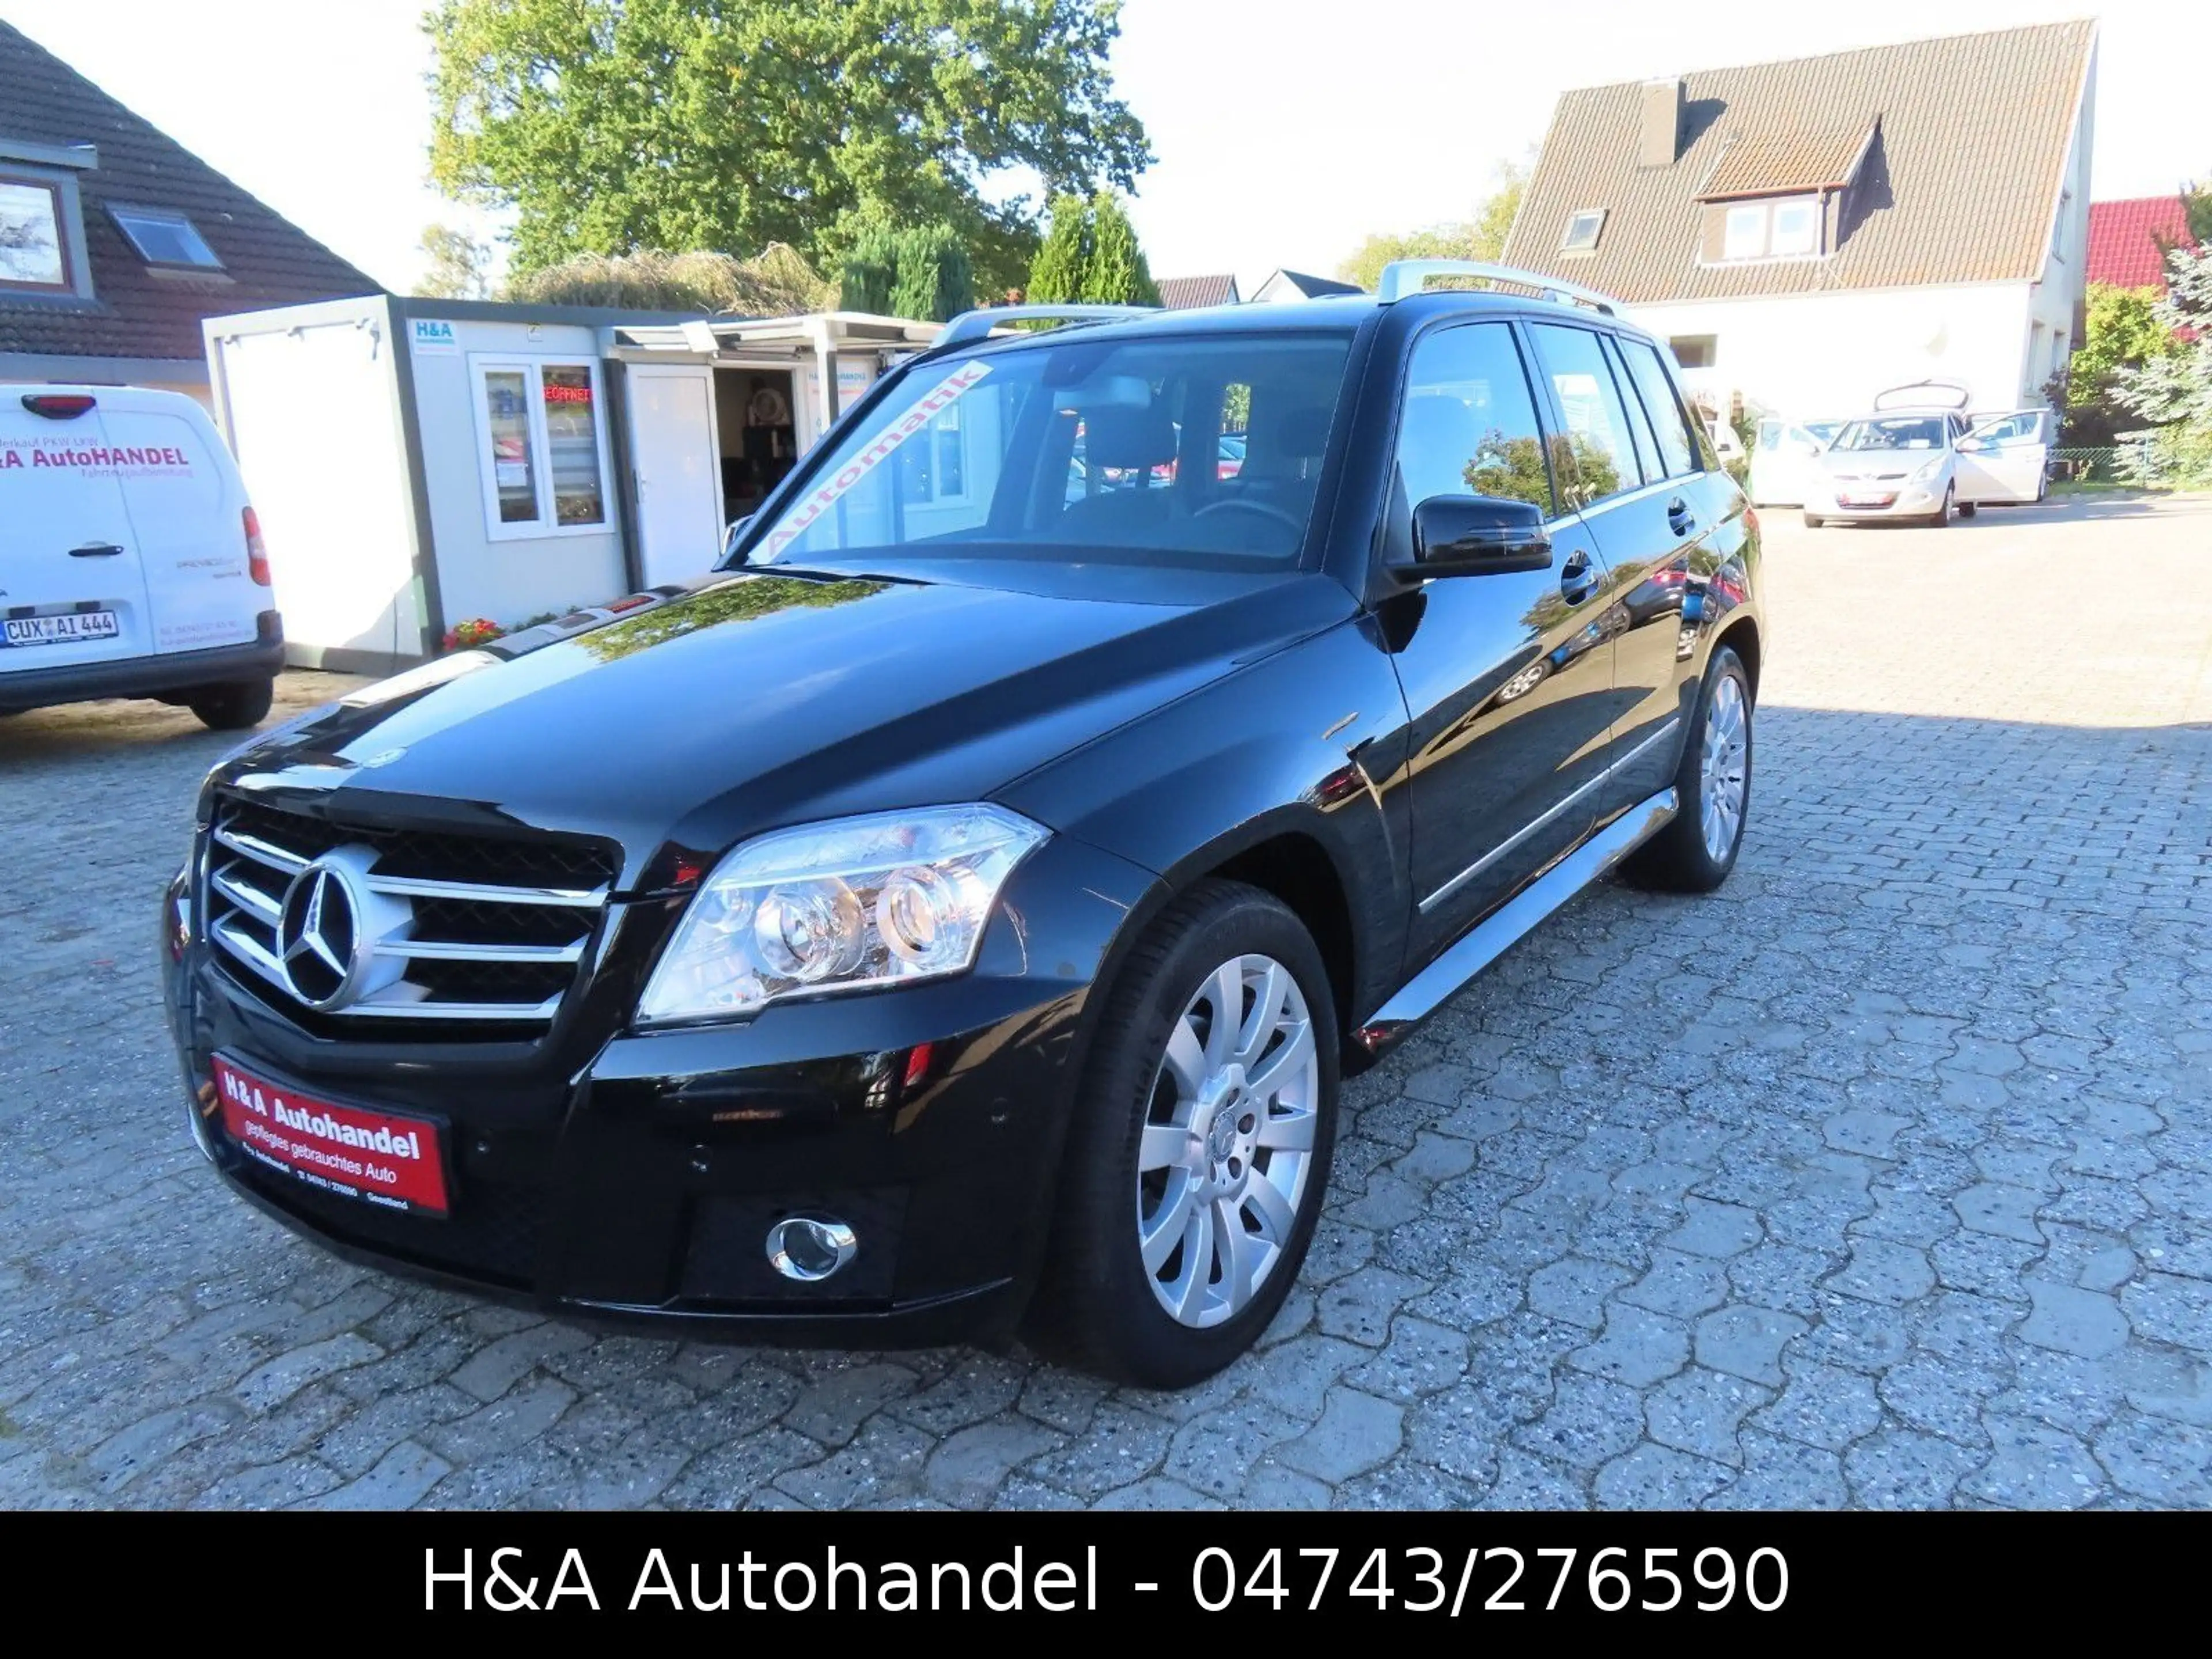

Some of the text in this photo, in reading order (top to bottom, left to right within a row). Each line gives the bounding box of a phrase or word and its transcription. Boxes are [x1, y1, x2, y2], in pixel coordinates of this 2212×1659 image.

[416, 321, 453, 337] H&A
[33, 448, 189, 467] AutoHANDEL
[767, 370, 981, 556] Automatik
[7, 614, 112, 639] CUX AI 444
[224, 1071, 267, 1116] H&A
[274, 1098, 420, 1160] Autohandel
[291, 1142, 362, 1176] gebrauchtes
[365, 1162, 397, 1184] Auto
